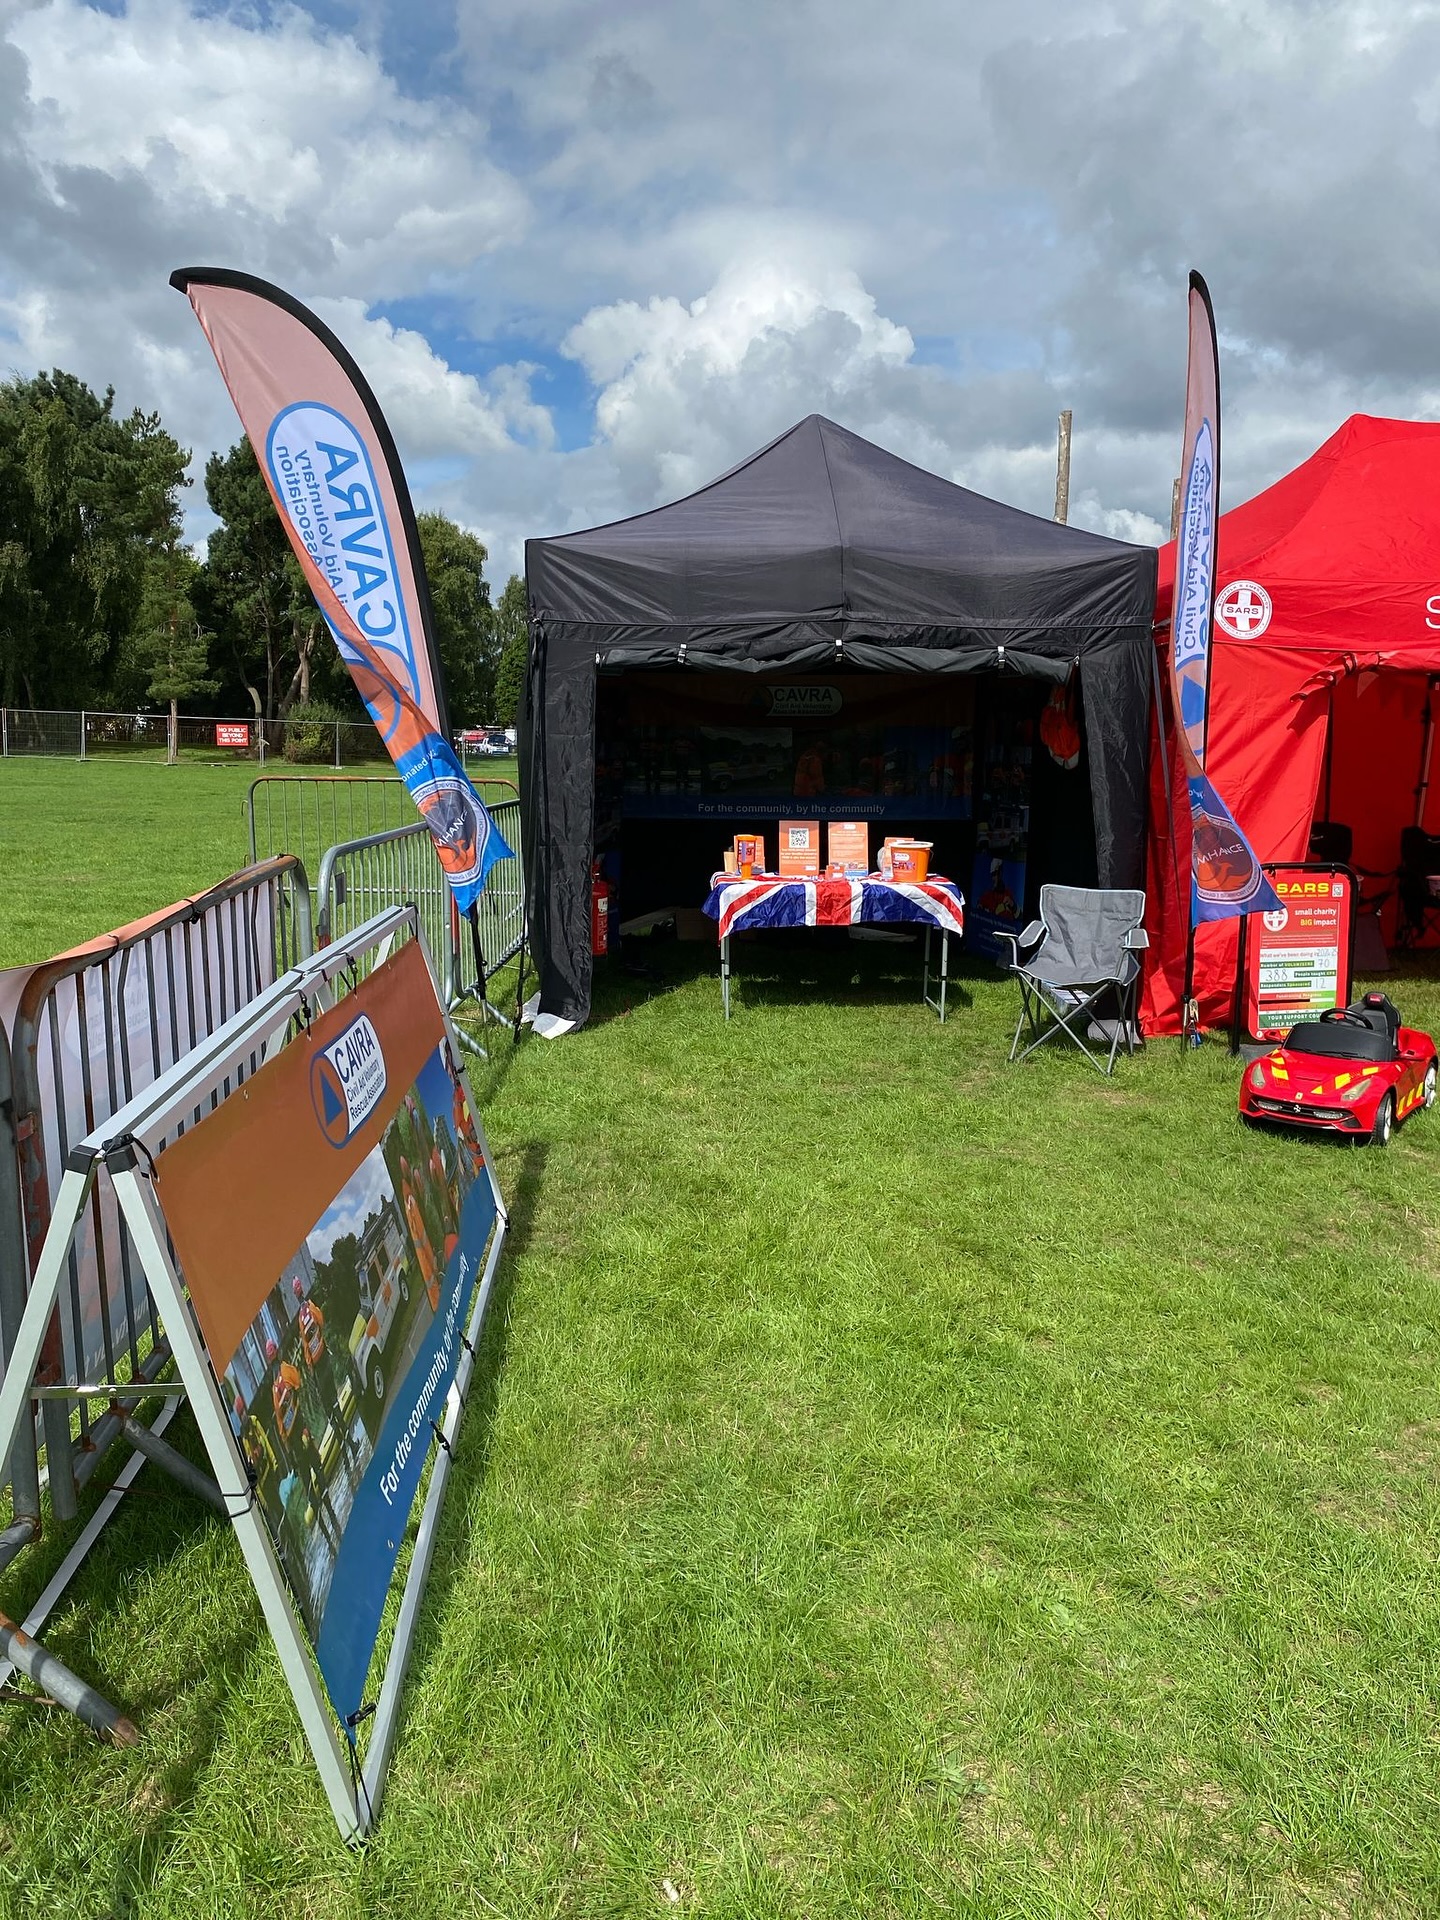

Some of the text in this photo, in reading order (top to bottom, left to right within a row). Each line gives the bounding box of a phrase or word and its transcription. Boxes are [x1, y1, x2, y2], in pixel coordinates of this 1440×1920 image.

[1226, 606, 1259, 615] SARS
[774, 688, 833, 702] CAVRA
[401, 757, 429, 783] onated
[697, 803, 885, 816] For the community, by the community
[1276, 882, 1330, 893] SARS
[1313, 907, 1337, 916] charity
[1300, 918, 1337, 927] BIG impact
[1317, 958, 1330, 968] 70
[1265, 968, 1288, 982] 388
[1315, 977, 1327, 989] 12
[334, 1021, 376, 1084] CAVRA
[349, 1095, 369, 1121] Rescue
[379, 1460, 400, 1506] For
[395, 1432, 412, 1470] the
[408, 1346, 450, 1439] community,
